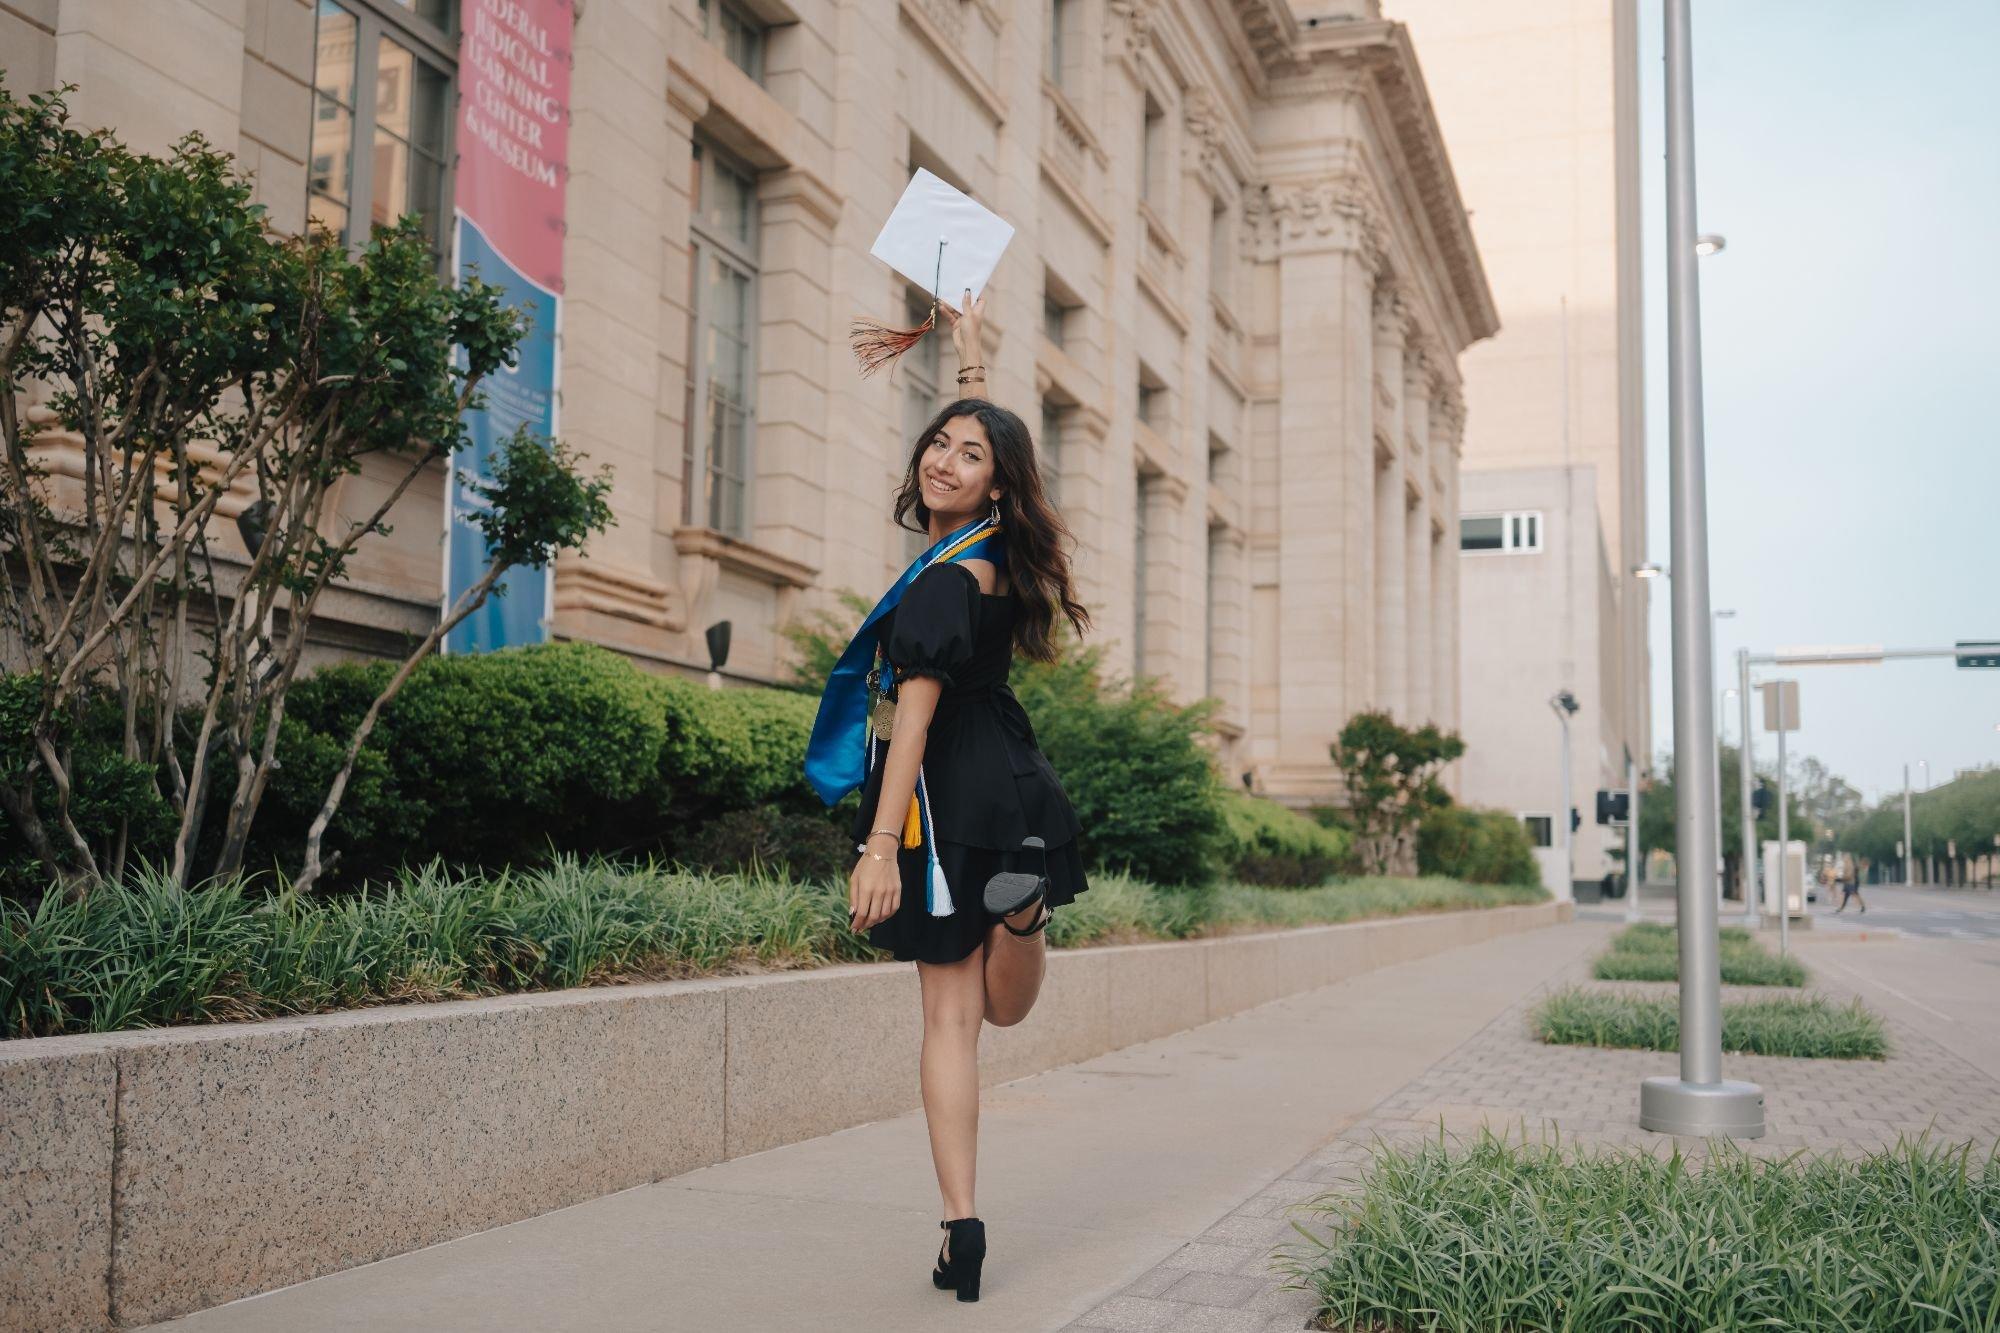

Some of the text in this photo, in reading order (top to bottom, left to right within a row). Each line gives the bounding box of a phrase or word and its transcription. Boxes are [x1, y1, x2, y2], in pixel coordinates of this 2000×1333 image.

[468, 36, 560, 123] LEARNING
[475, 8, 553, 88] JUDICIAL
[476, 80, 542, 149] CENTER
[480, 121, 557, 188] MUSEUM
